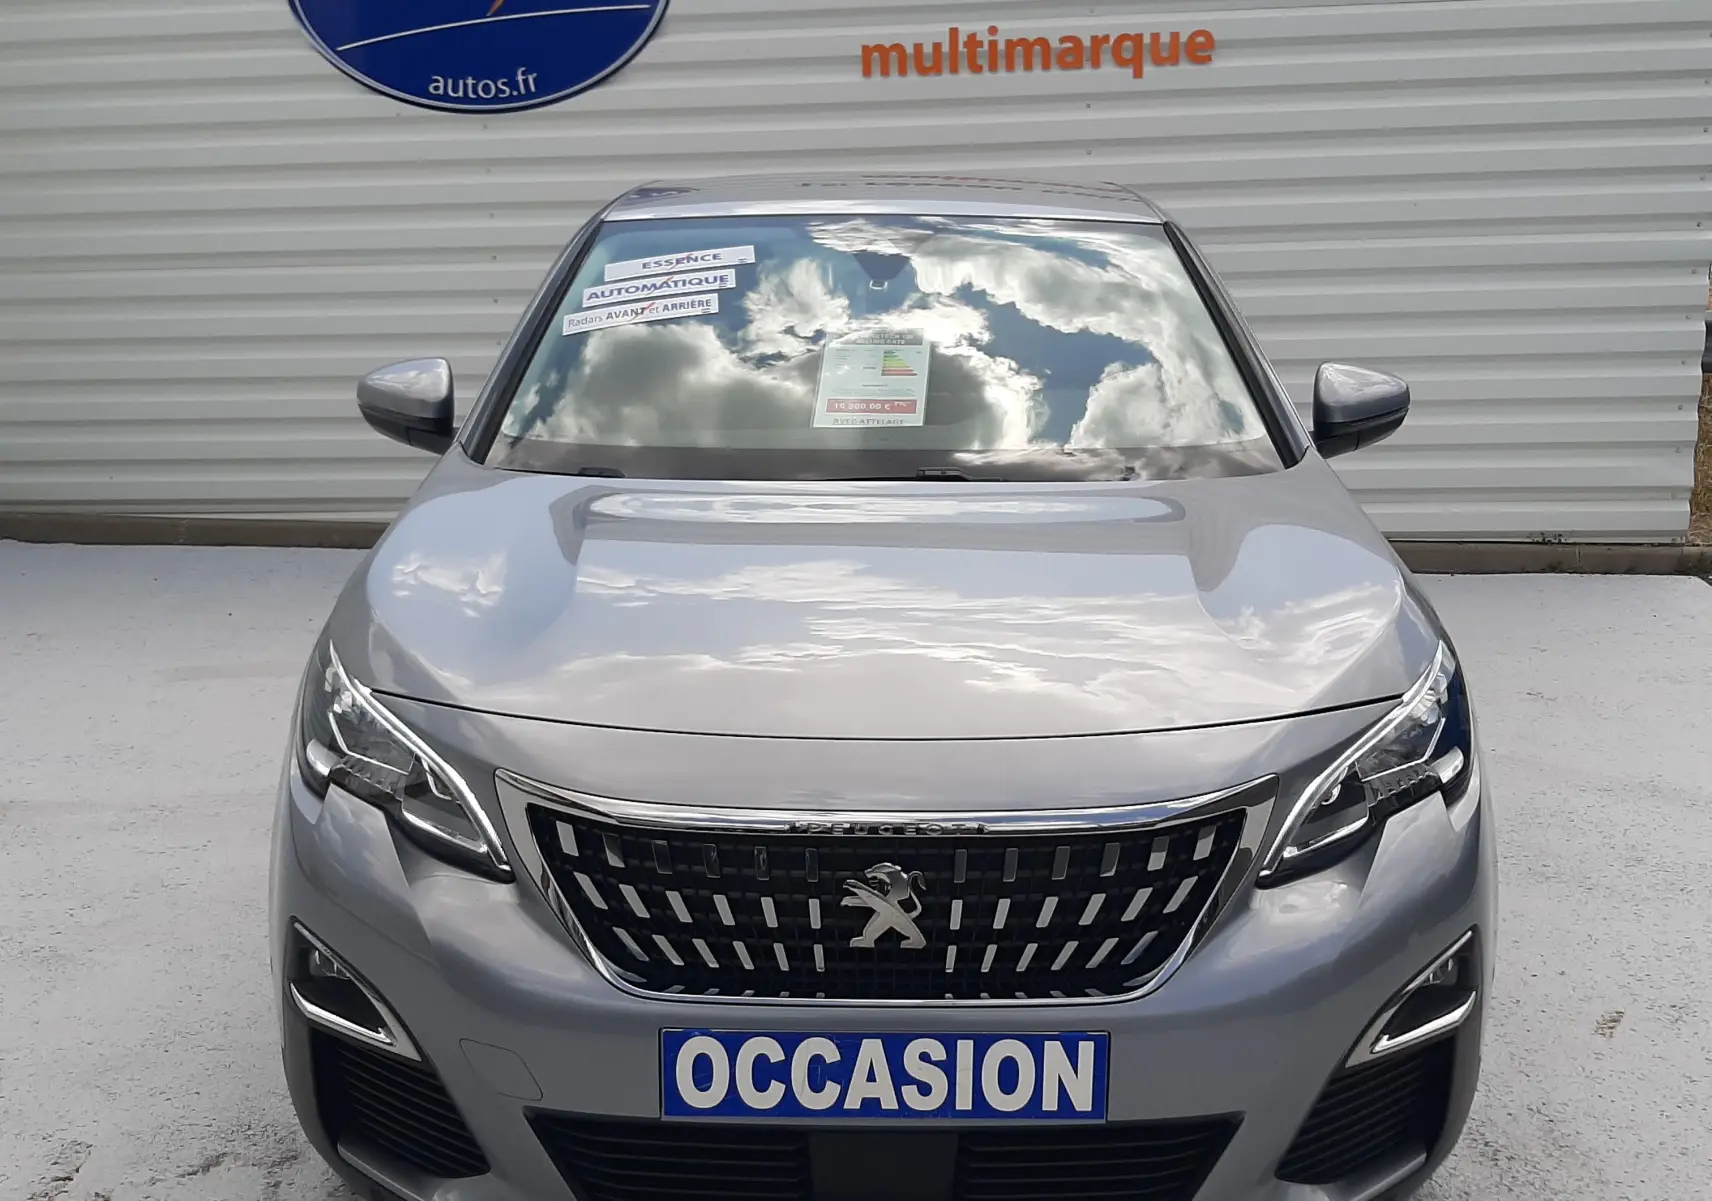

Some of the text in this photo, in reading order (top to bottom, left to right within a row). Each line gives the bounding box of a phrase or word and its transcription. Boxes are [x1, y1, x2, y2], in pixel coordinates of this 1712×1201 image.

[860, 25, 1215, 78] multimarque
[428, 67, 538, 99] autos.fr
[642, 252, 722, 269] ESSENCE
[586, 274, 729, 301] AUTOMATIQUE
[567, 313, 603, 328] Radars
[606, 306, 646, 320] AVANT
[649, 306, 660, 315] et
[662, 298, 712, 313] ARRIÈRE
[807, 822, 967, 836] PEUGEOT
[675, 1035, 1096, 1112] OCCASION
